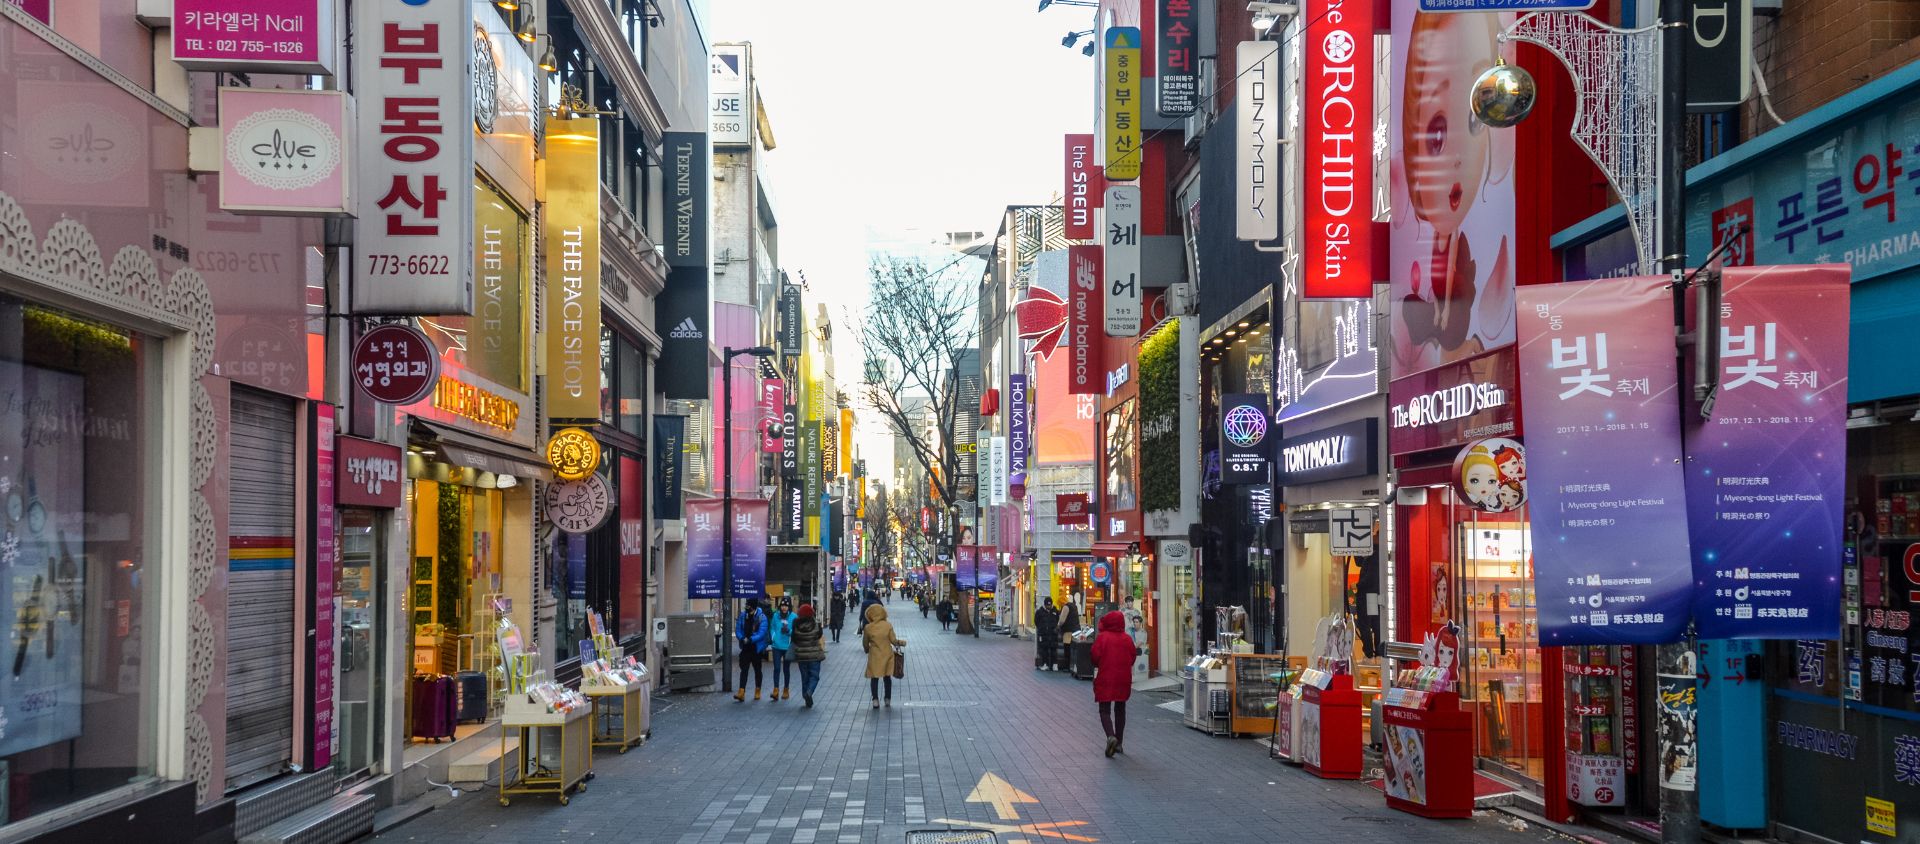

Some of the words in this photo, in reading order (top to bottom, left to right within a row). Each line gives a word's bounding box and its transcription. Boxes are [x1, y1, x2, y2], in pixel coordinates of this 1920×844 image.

[185, 11, 259, 32] 키라엘라
[265, 14, 303, 32] Nail
[186, 39, 204, 50] TEL
[241, 40, 303, 54] 755-1526
[1117, 54, 1129, 83] 중앙
[376, 22, 447, 237] 부동산
[1115, 88, 1131, 153] 부동산
[1322, 29, 1356, 217] ORCHID
[252, 128, 317, 159] clue
[1252, 62, 1265, 219] TONYMOLY
[676, 142, 693, 196] TEENIE
[1073, 145, 1087, 169] the
[1072, 172, 1087, 226] SAEM
[677, 197, 693, 257] WEENIE
[563, 225, 582, 272] THE
[1109, 222, 1137, 298] 헤어
[1325, 222, 1351, 280] Skin
[368, 254, 450, 276] 773-6622
[563, 275, 583, 332] FACE
[1076, 292, 1087, 322] new
[670, 328, 703, 339] adidas
[370, 341, 408, 358] 노정식
[1076, 324, 1090, 385] balance
[1720, 322, 1780, 391] 빛
[358, 361, 428, 388] 성형외과
[563, 336, 583, 398] SHOP
[1551, 332, 1614, 401] 빛
[1783, 370, 1818, 389] 축제
[1616, 377, 1650, 397] 축제
[1012, 382, 1024, 428] HOLIKA
[1077, 404, 1094, 420] HO
[1392, 405, 1408, 428] The
[1409, 383, 1475, 428] ORCHID
[1476, 382, 1502, 411] Skin
[1804, 415, 1814, 423] 15
[556, 434, 583, 448] FACE
[580, 440, 592, 469] SHOP
[666, 435, 676, 466] TEENIE
[784, 412, 796, 469] GUESS
[808, 428, 816, 464] NATURE
[1012, 431, 1024, 477] HOLIKA
[1283, 435, 1347, 474] TONYMOLY
[552, 446, 562, 468] THE
[1232, 463, 1259, 472] O.S.T
[808, 465, 816, 509] REPUBLIC
[980, 451, 988, 499] MISSHA
[792, 487, 801, 530] ARITAUM
[1568, 500, 1619, 510] Myeong-dong
[1619, 499, 1637, 509] Light
[1638, 498, 1665, 506] Festival
[1723, 494, 1775, 503] Myeong-dong
[1776, 494, 1793, 503] Light
[1795, 493, 1823, 501] Festival
[694, 512, 711, 532] 빛
[736, 512, 752, 532] 빛
[621, 522, 641, 556] SALE
[1613, 613, 1665, 624] 乐天免税店
[1757, 607, 1809, 618] 乐天免税店
[1866, 630, 1908, 654] Ginseng
[1726, 658, 1742, 669] 1F
[1778, 720, 1858, 760] PHARMACY
[1597, 789, 1612, 801] 2F
